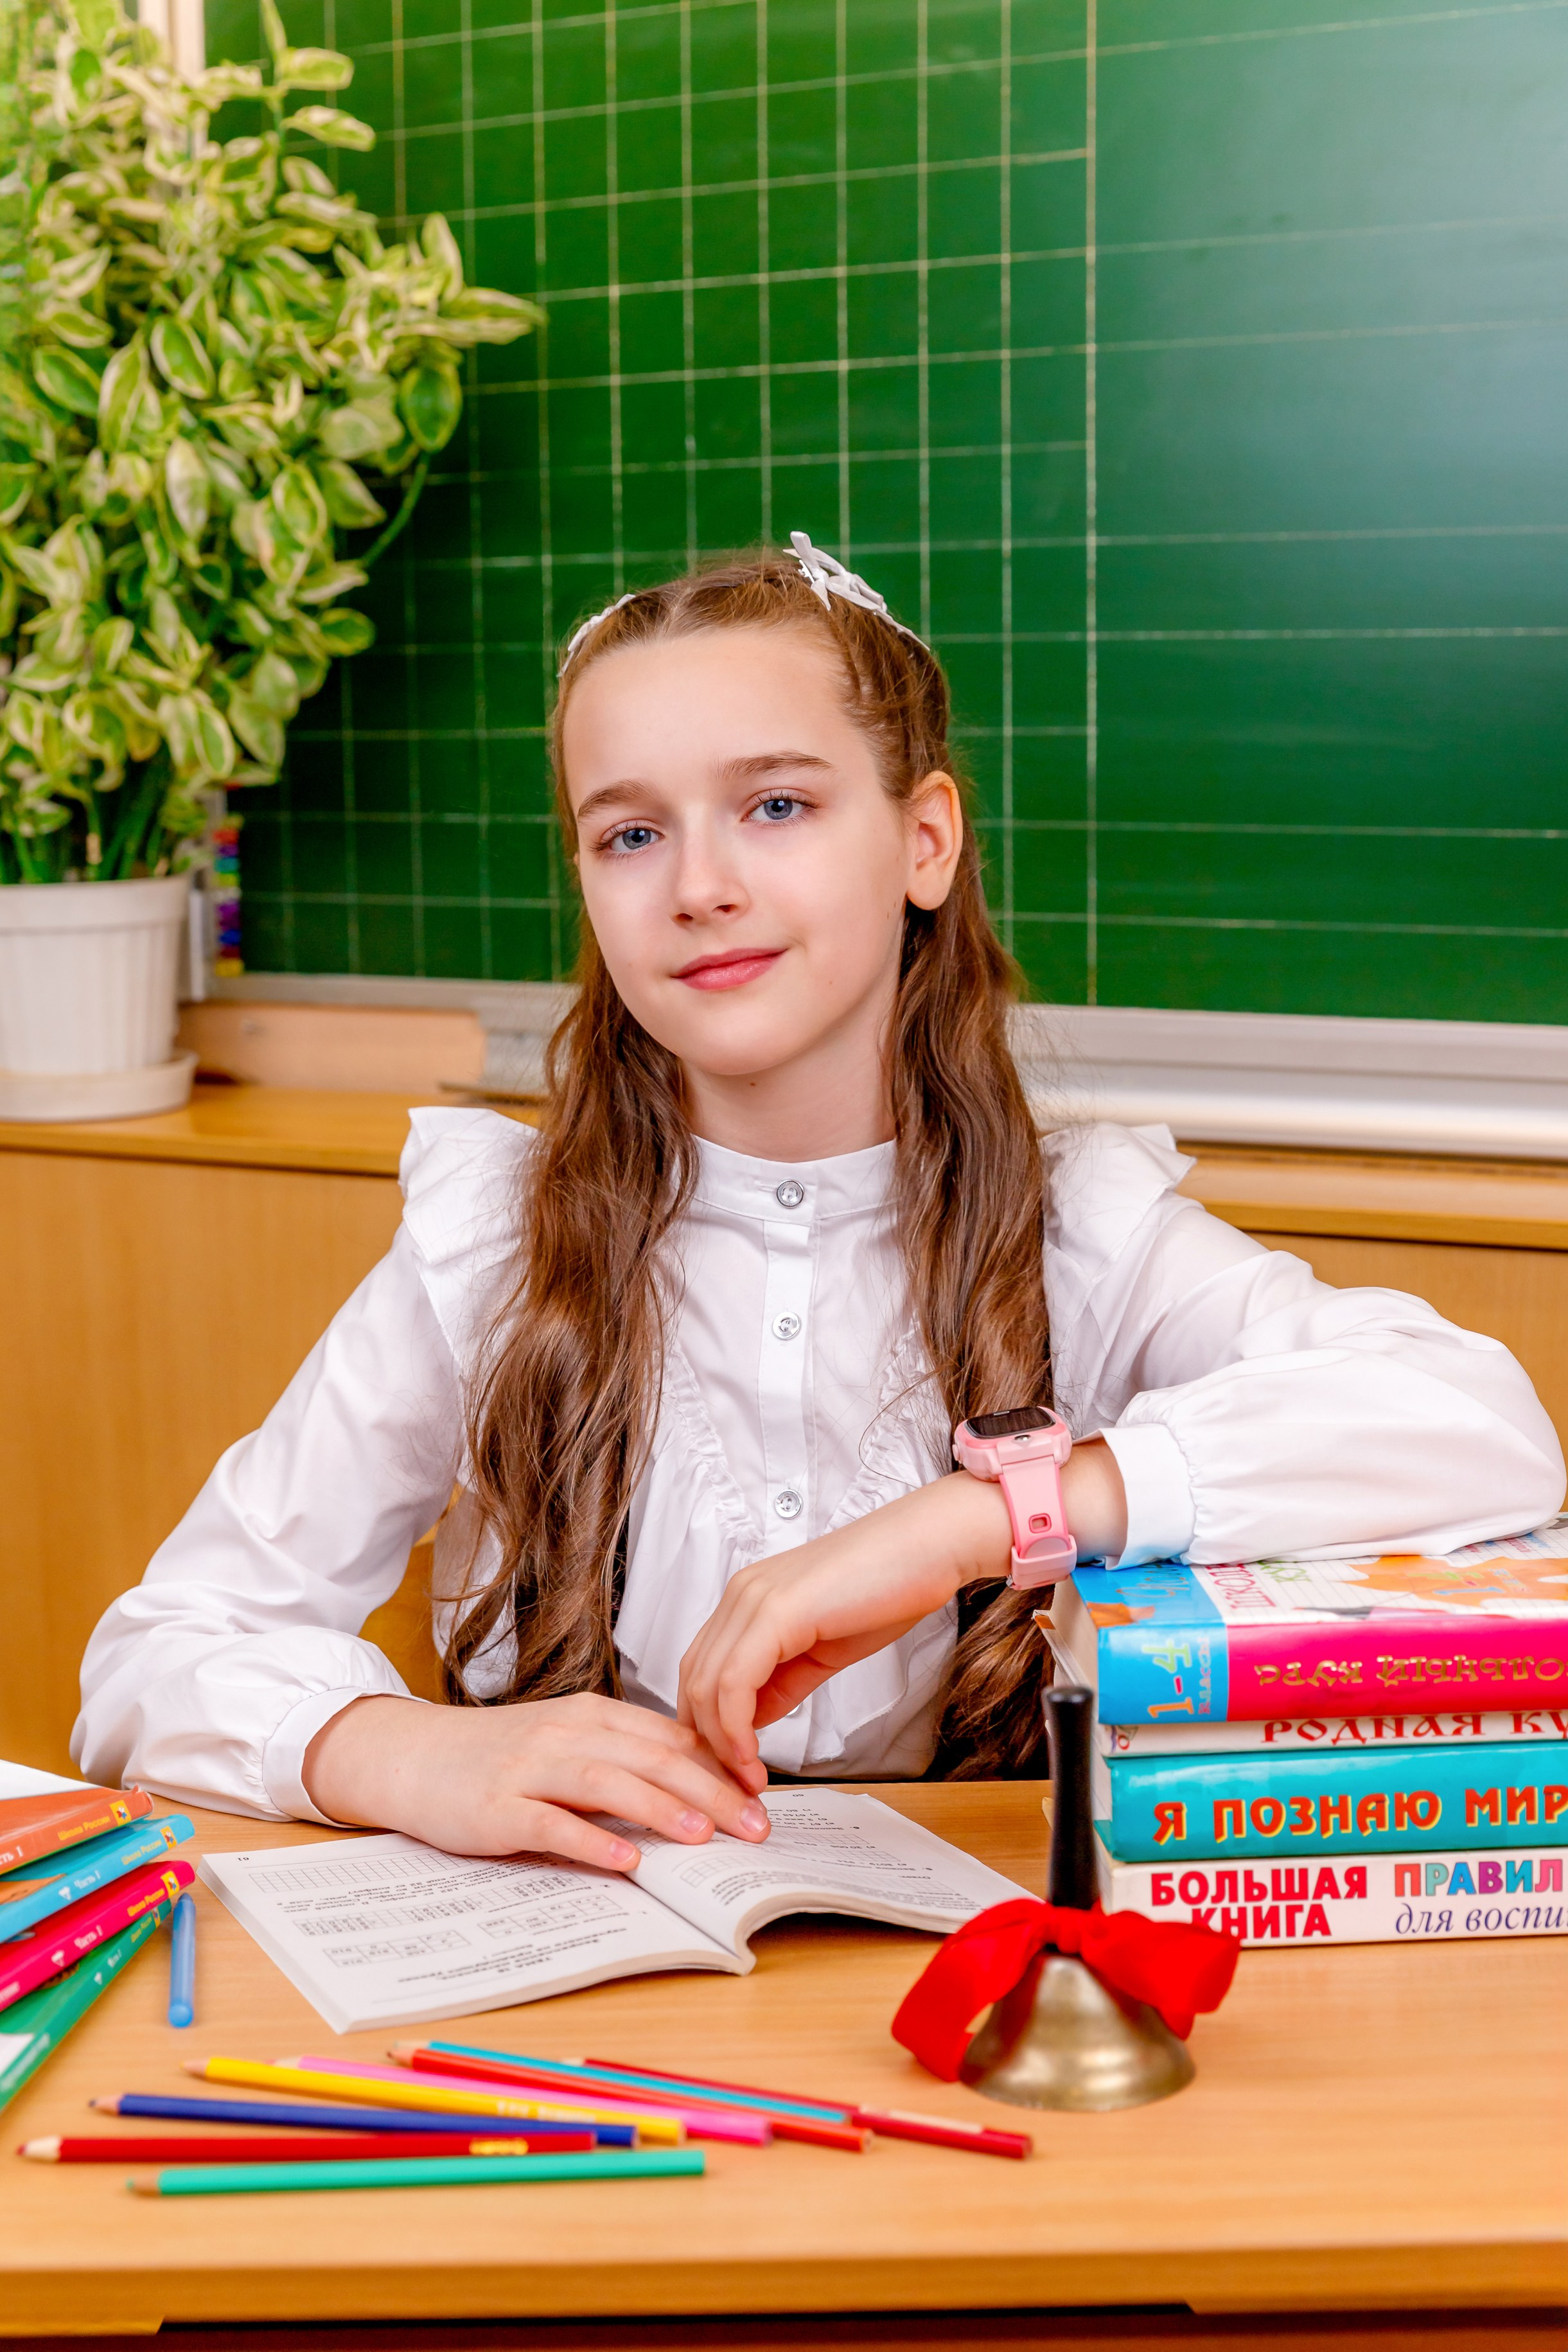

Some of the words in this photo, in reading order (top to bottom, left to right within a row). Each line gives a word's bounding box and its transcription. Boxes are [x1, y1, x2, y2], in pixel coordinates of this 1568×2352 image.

[1141, 1639, 1194, 1718] 1-4
[1254, 1659, 1363, 1687] КУРС
[1377, 1654, 1568, 1688] ОЛЬНЫЙ
[1261, 1713, 1486, 1745] РОДНАЯ
[1153, 1801, 1188, 1845] Я
[1213, 1791, 1443, 1844] ПОЗНАЮ
[1465, 1785, 1568, 1827] МИР
[1151, 1866, 1368, 1907] БОЛЬШАЯ
[1395, 1859, 1563, 1897] ПРАВИЛ
[1192, 1904, 1332, 1939] КНИГА
[1396, 1902, 1454, 1934] для
[1466, 1905, 1568, 1931] воспи
